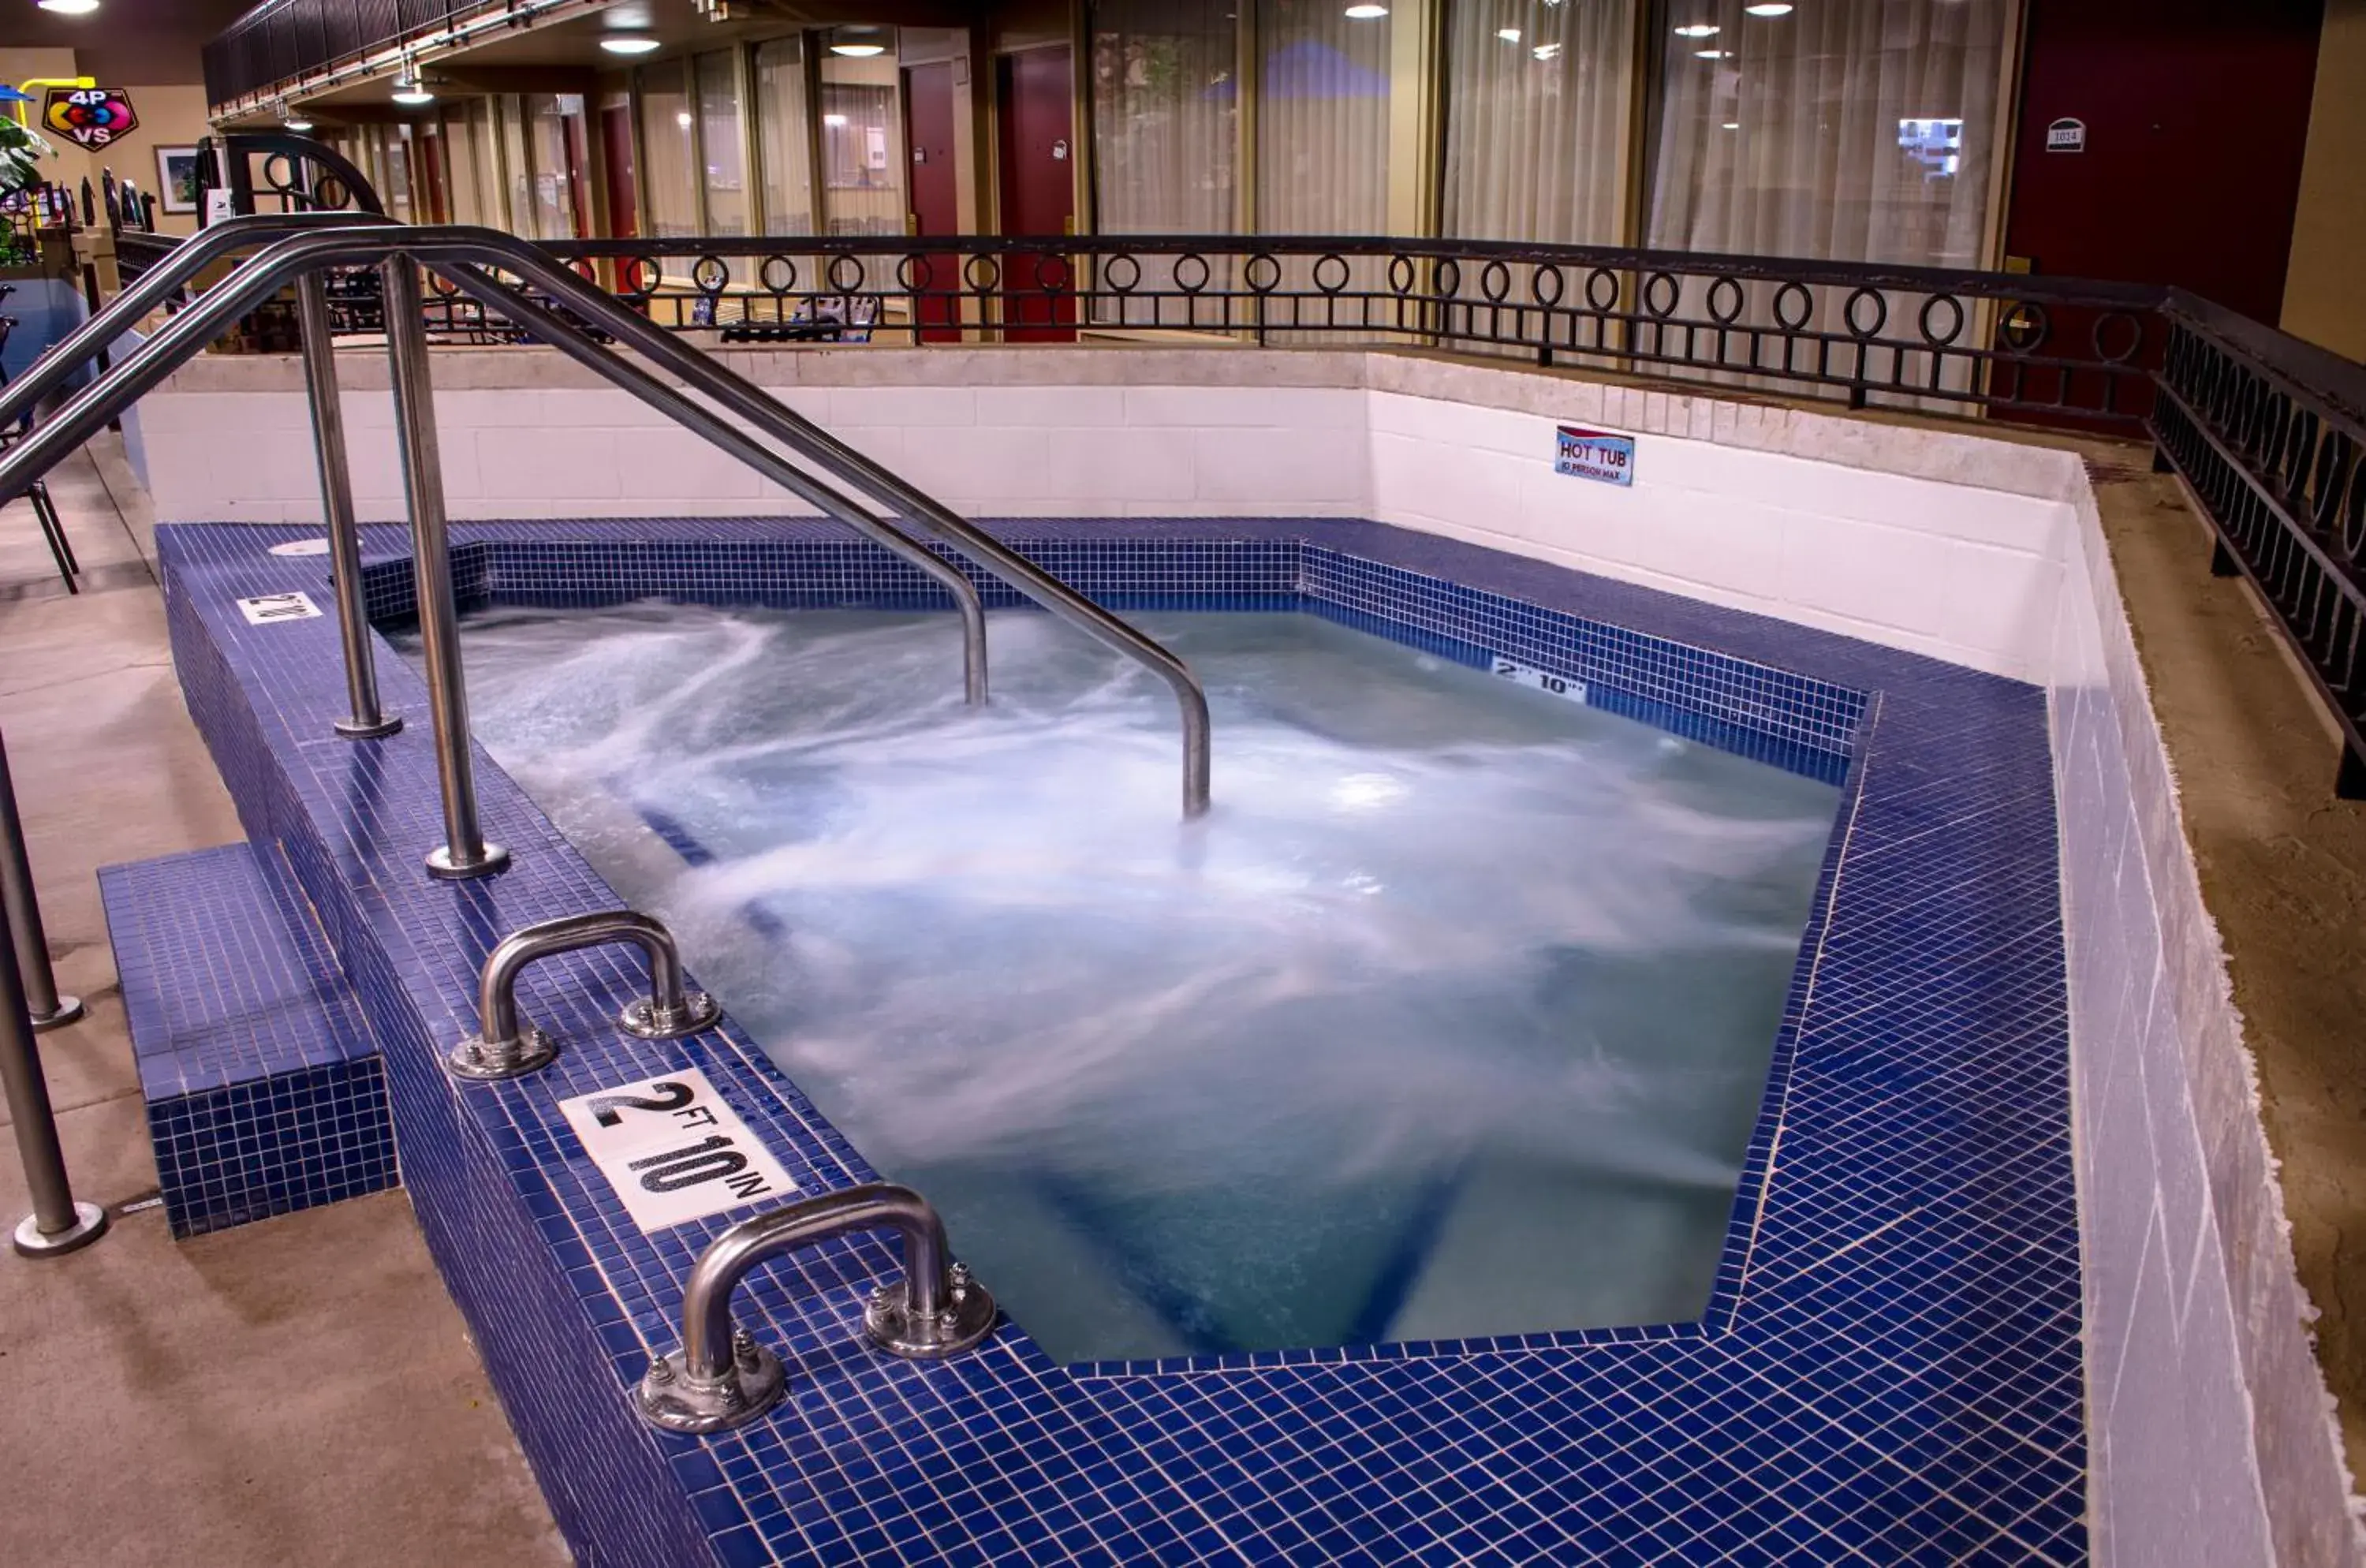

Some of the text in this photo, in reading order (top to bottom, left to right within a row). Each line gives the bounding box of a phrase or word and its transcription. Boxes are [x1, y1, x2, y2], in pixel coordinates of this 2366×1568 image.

[69, 91, 106, 105] 4P
[73, 127, 111, 143] VS
[1561, 441, 1626, 467] HOT TUB
[1602, 471, 1621, 480] MAX
[1497, 663, 1517, 674] 2
[1539, 674, 1566, 694] 10
[588, 1081, 718, 1129] 2 FT
[628, 1135, 772, 1199] 10 IN
